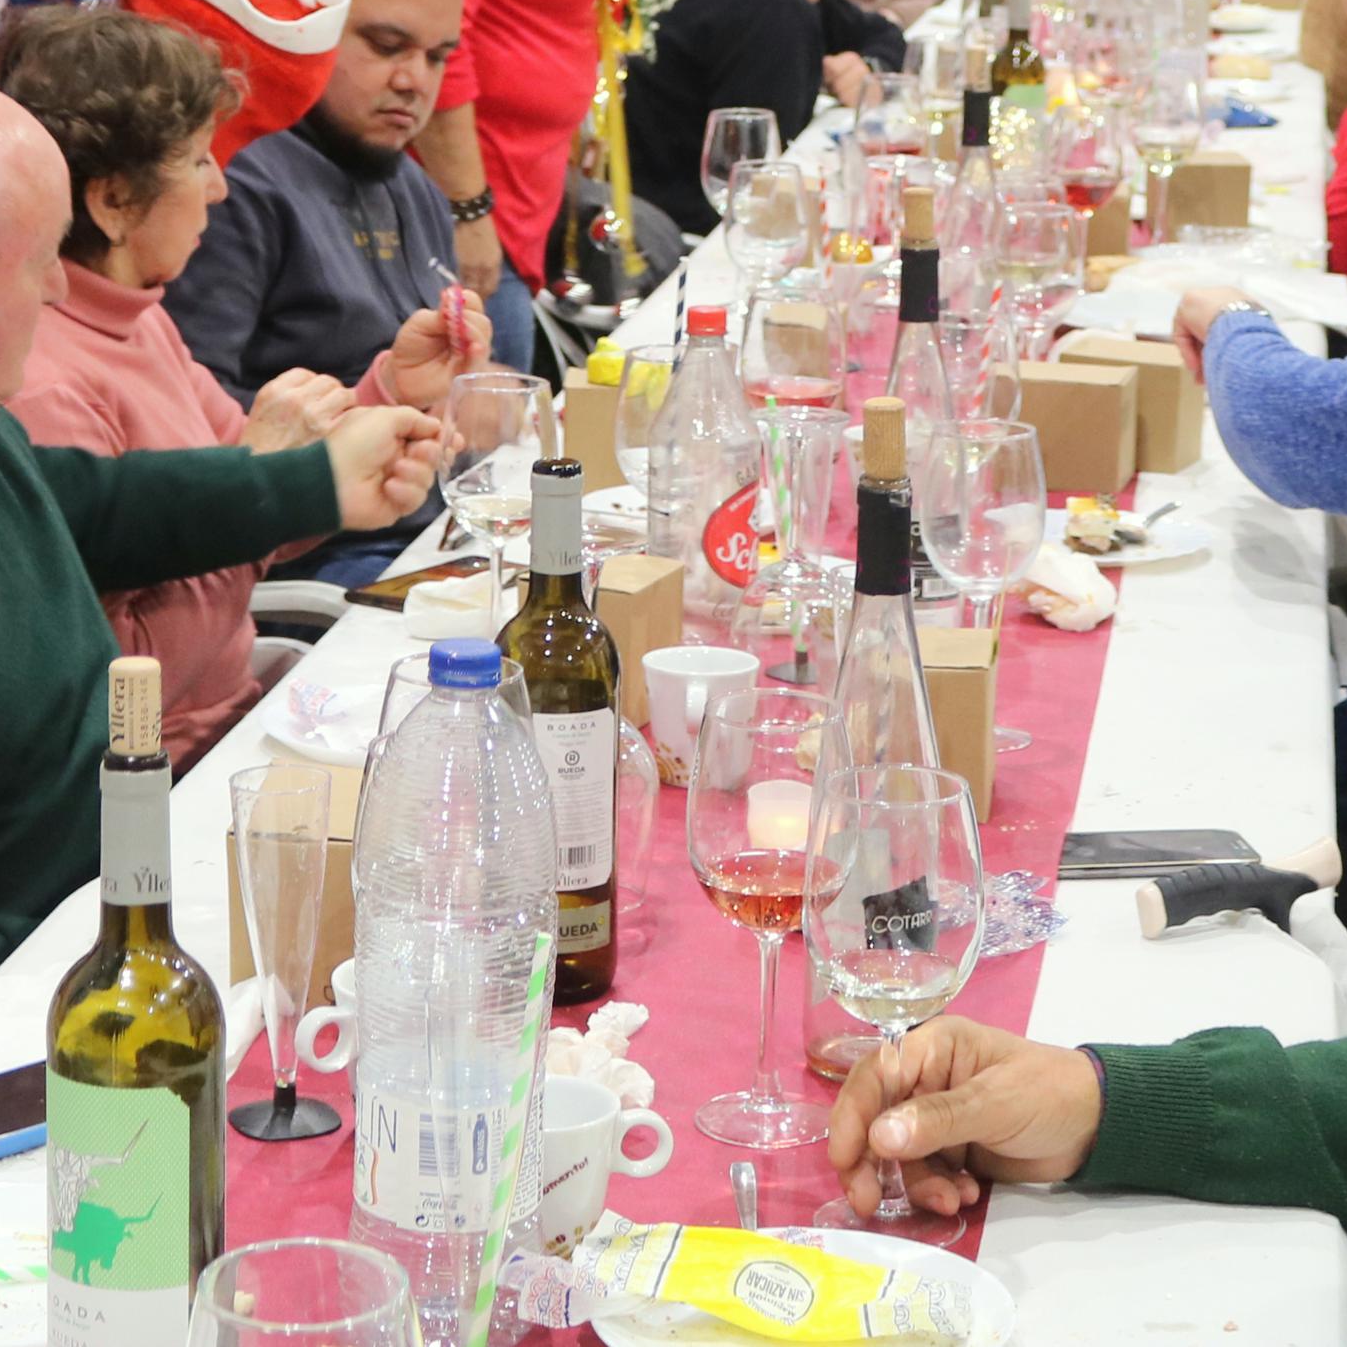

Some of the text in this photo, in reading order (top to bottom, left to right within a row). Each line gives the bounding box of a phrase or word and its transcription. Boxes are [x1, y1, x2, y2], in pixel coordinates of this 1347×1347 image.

[111, 677, 125, 745] Yllera
[547, 721, 597, 732] BOADA
[558, 921, 599, 939] UEDA
[787, 1286, 807, 1302] SIN
